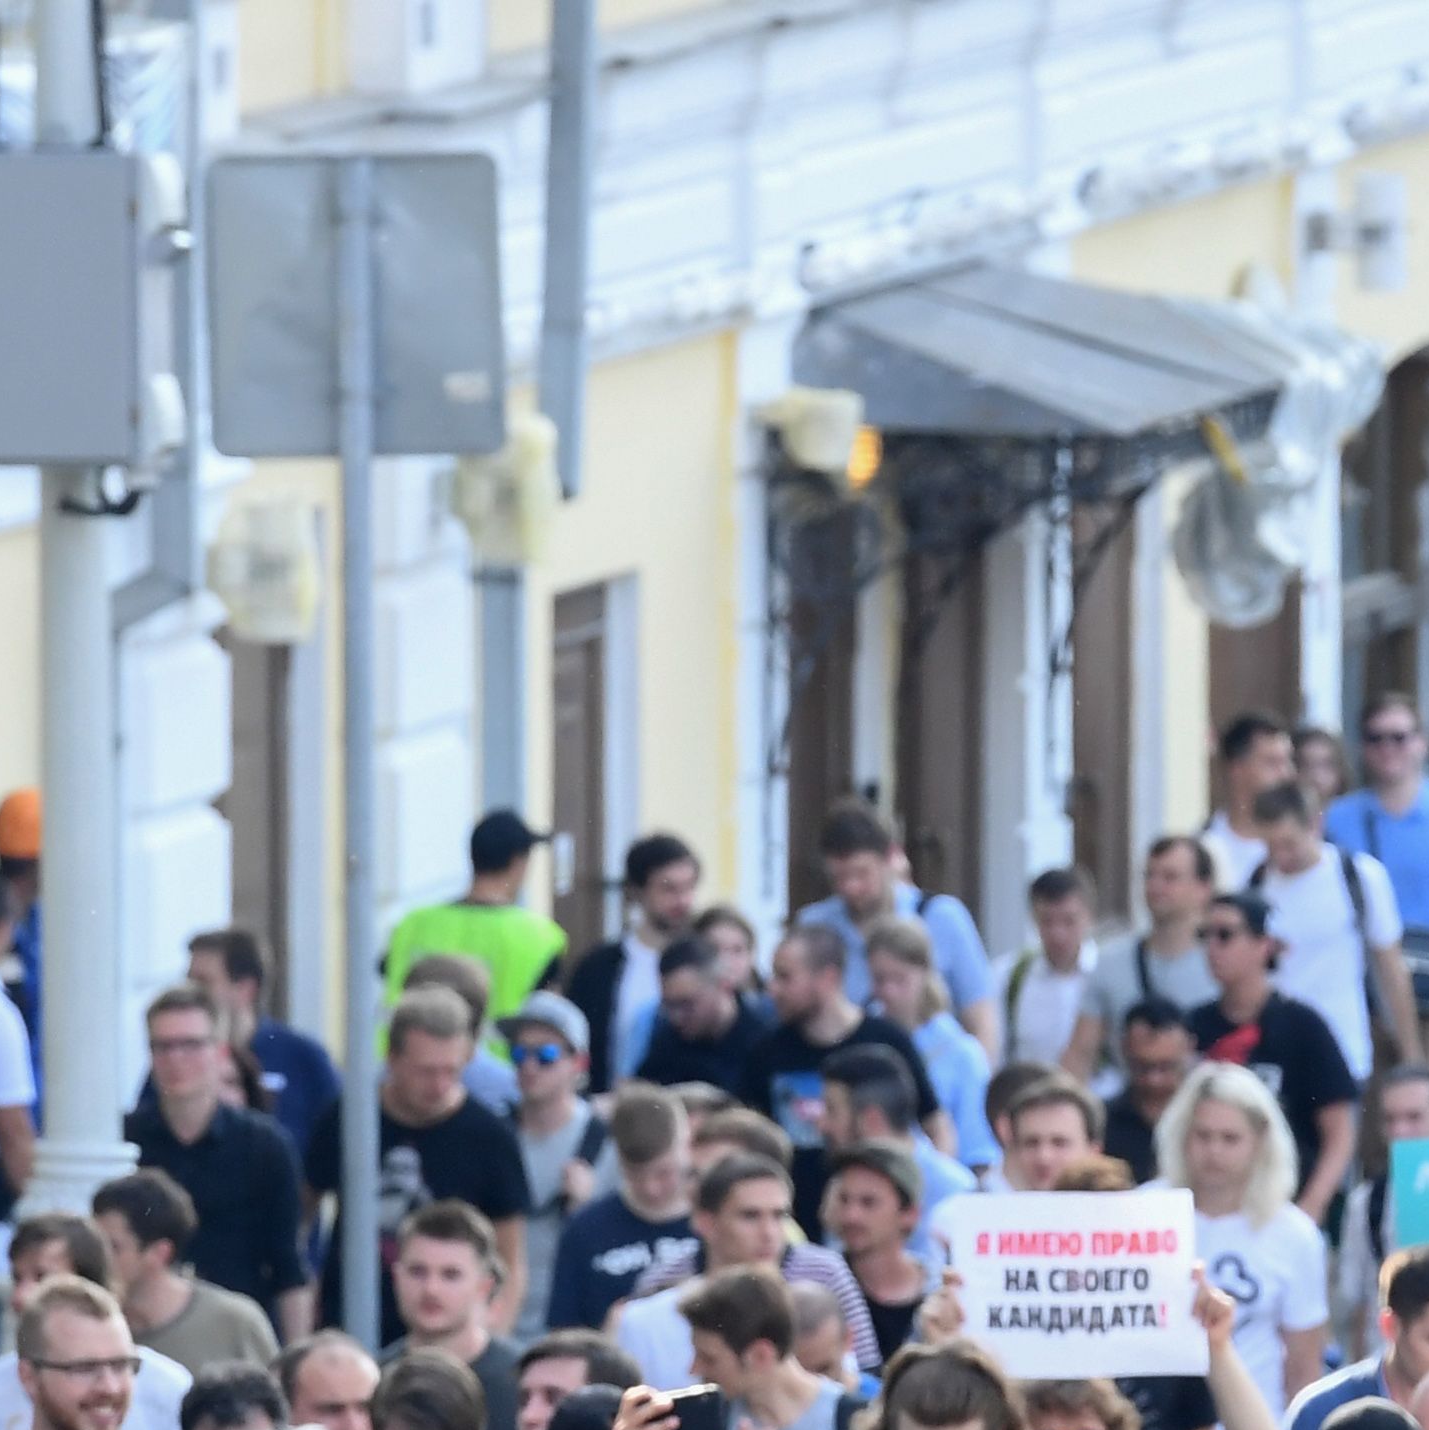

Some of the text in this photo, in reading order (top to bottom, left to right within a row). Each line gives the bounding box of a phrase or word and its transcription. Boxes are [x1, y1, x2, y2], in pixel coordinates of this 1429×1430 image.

[976, 1230, 1178, 1257] Я ИМЕЮ ПРАВО
[1005, 1267, 1150, 1293] НА СВОЕГО
[988, 1303, 1167, 1334] КАНДИДАТА!
